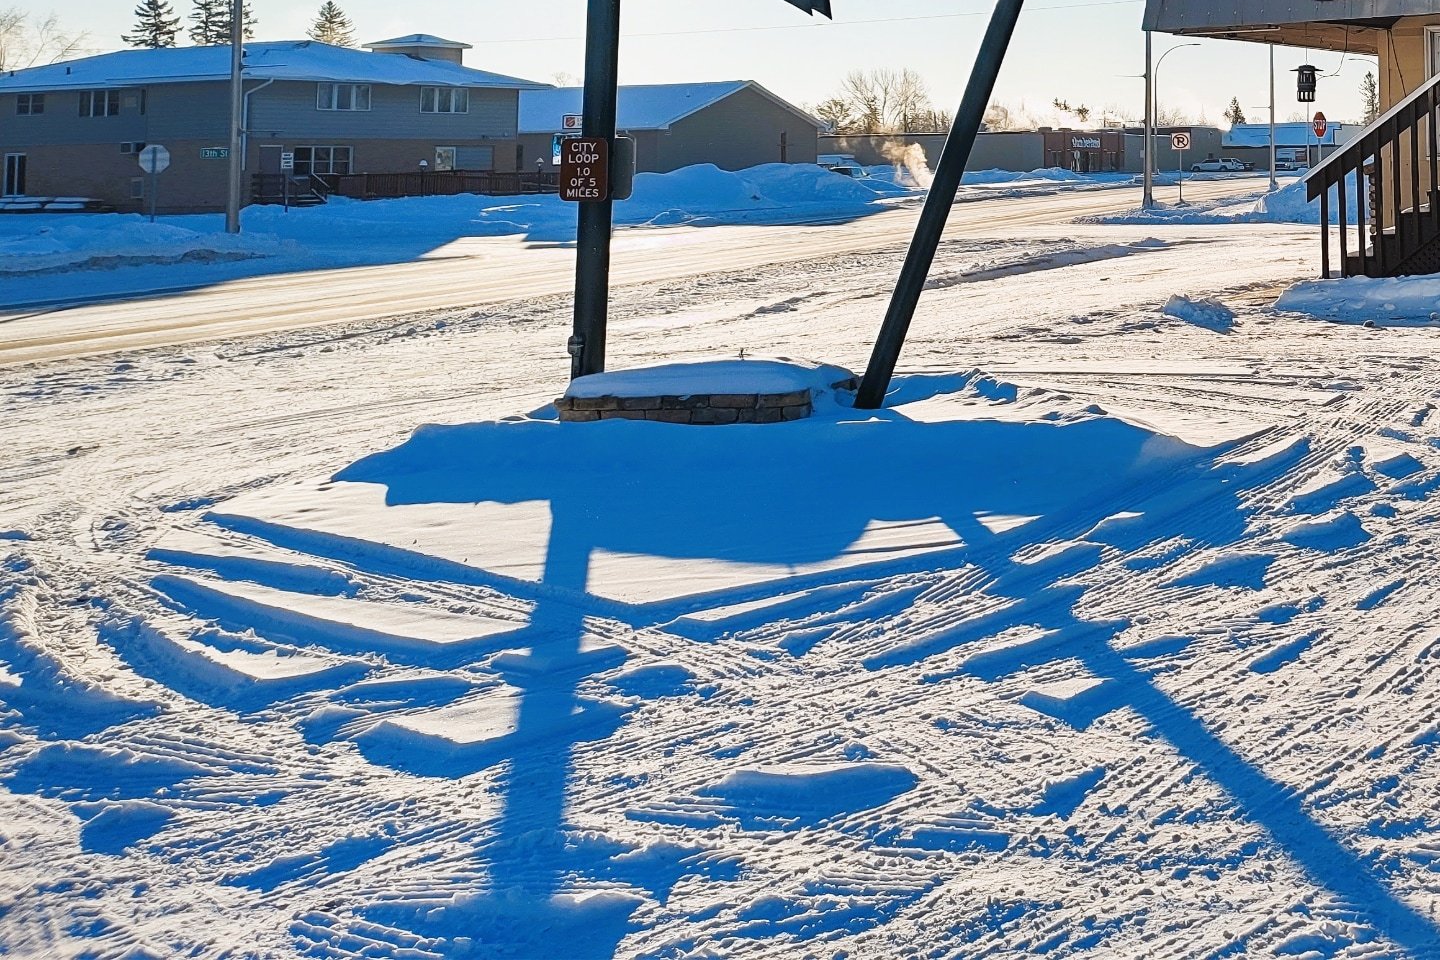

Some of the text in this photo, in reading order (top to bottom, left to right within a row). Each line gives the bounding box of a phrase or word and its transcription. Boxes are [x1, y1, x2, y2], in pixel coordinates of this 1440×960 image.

[1314, 119, 1326, 130] STOP
[571, 142, 597, 152] CITY
[202, 149, 228, 158] 13th St
[568, 154, 599, 164] LOOP
[577, 167, 591, 176] 1.0
[570, 178, 596, 187] OF 5
[566, 188, 599, 198] MILES
